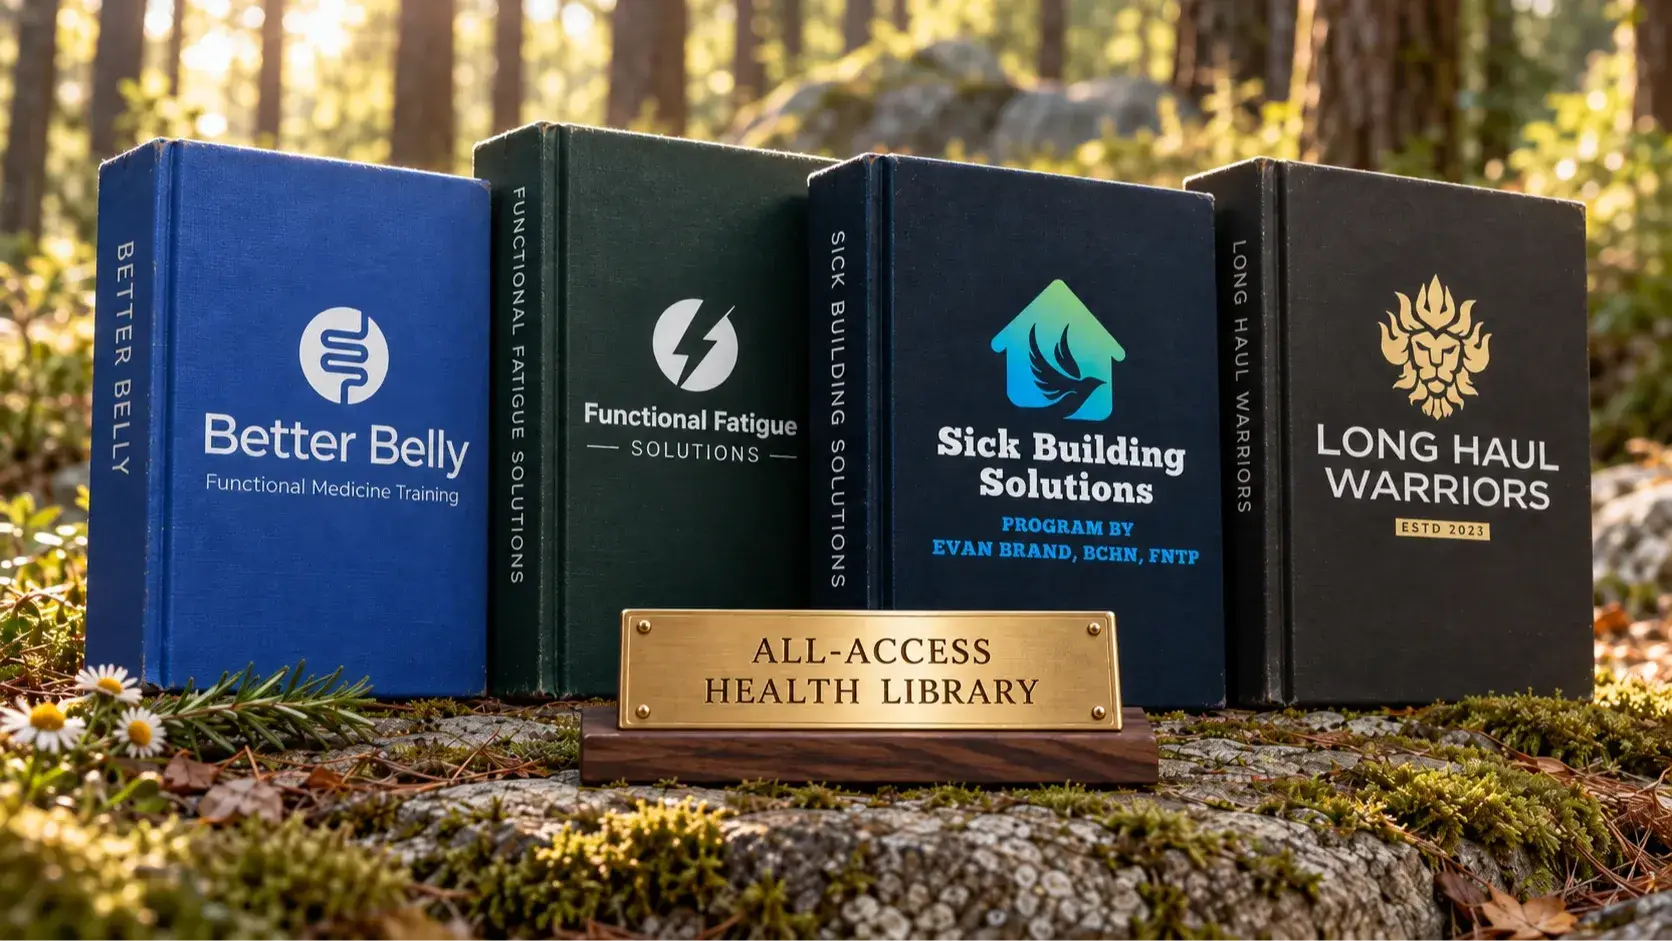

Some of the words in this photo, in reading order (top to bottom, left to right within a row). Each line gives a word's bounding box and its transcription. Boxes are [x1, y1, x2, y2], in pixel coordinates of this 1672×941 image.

[513, 187, 525, 335] FUNCTIONAL
[832, 231, 845, 288] SICK
[1233, 240, 1247, 304] LONG
[115, 241, 134, 366] BETTER
[832, 301, 844, 425] BUILDING
[1235, 318, 1248, 381] HAUL
[512, 346, 524, 439] FATIGUE
[112, 379, 131, 474] BELLY
[205, 413, 356, 462] Better
[371, 424, 469, 479] Belly
[585, 402, 706, 430] Functional
[715, 411, 797, 438] Fatigue
[632, 440, 758, 462] SOLUTIONS
[938, 427, 1020, 459] Sick
[1033, 432, 1186, 476] Building
[1237, 391, 1251, 512] WARRIORS
[1318, 424, 1437, 462] LONG
[1454, 435, 1559, 471] HAUL
[207, 474, 304, 494] Functional
[313, 480, 390, 498] Medicine
[396, 485, 458, 506] Training
[980, 468, 1153, 504] Solutions
[1325, 467, 1551, 510] WARRIORS
[511, 451, 524, 583] SOLUTIONS
[832, 440, 845, 587] SOLUTIONS
[1003, 517, 1103, 535] PROGRAM
[1109, 522, 1134, 536] BY
[1401, 521, 1441, 534] ESTD
[1449, 524, 1484, 537] 2023
[933, 539, 992, 556] EVAN
[1000, 542, 1077, 562] BRAND,
[1084, 546, 1143, 565] BCHN,
[1149, 549, 1199, 564] FNTP
[752, 638, 990, 664] ALL-ACCESS
[705, 678, 859, 703] HEALTH
[881, 679, 1039, 704] LIBRARY
